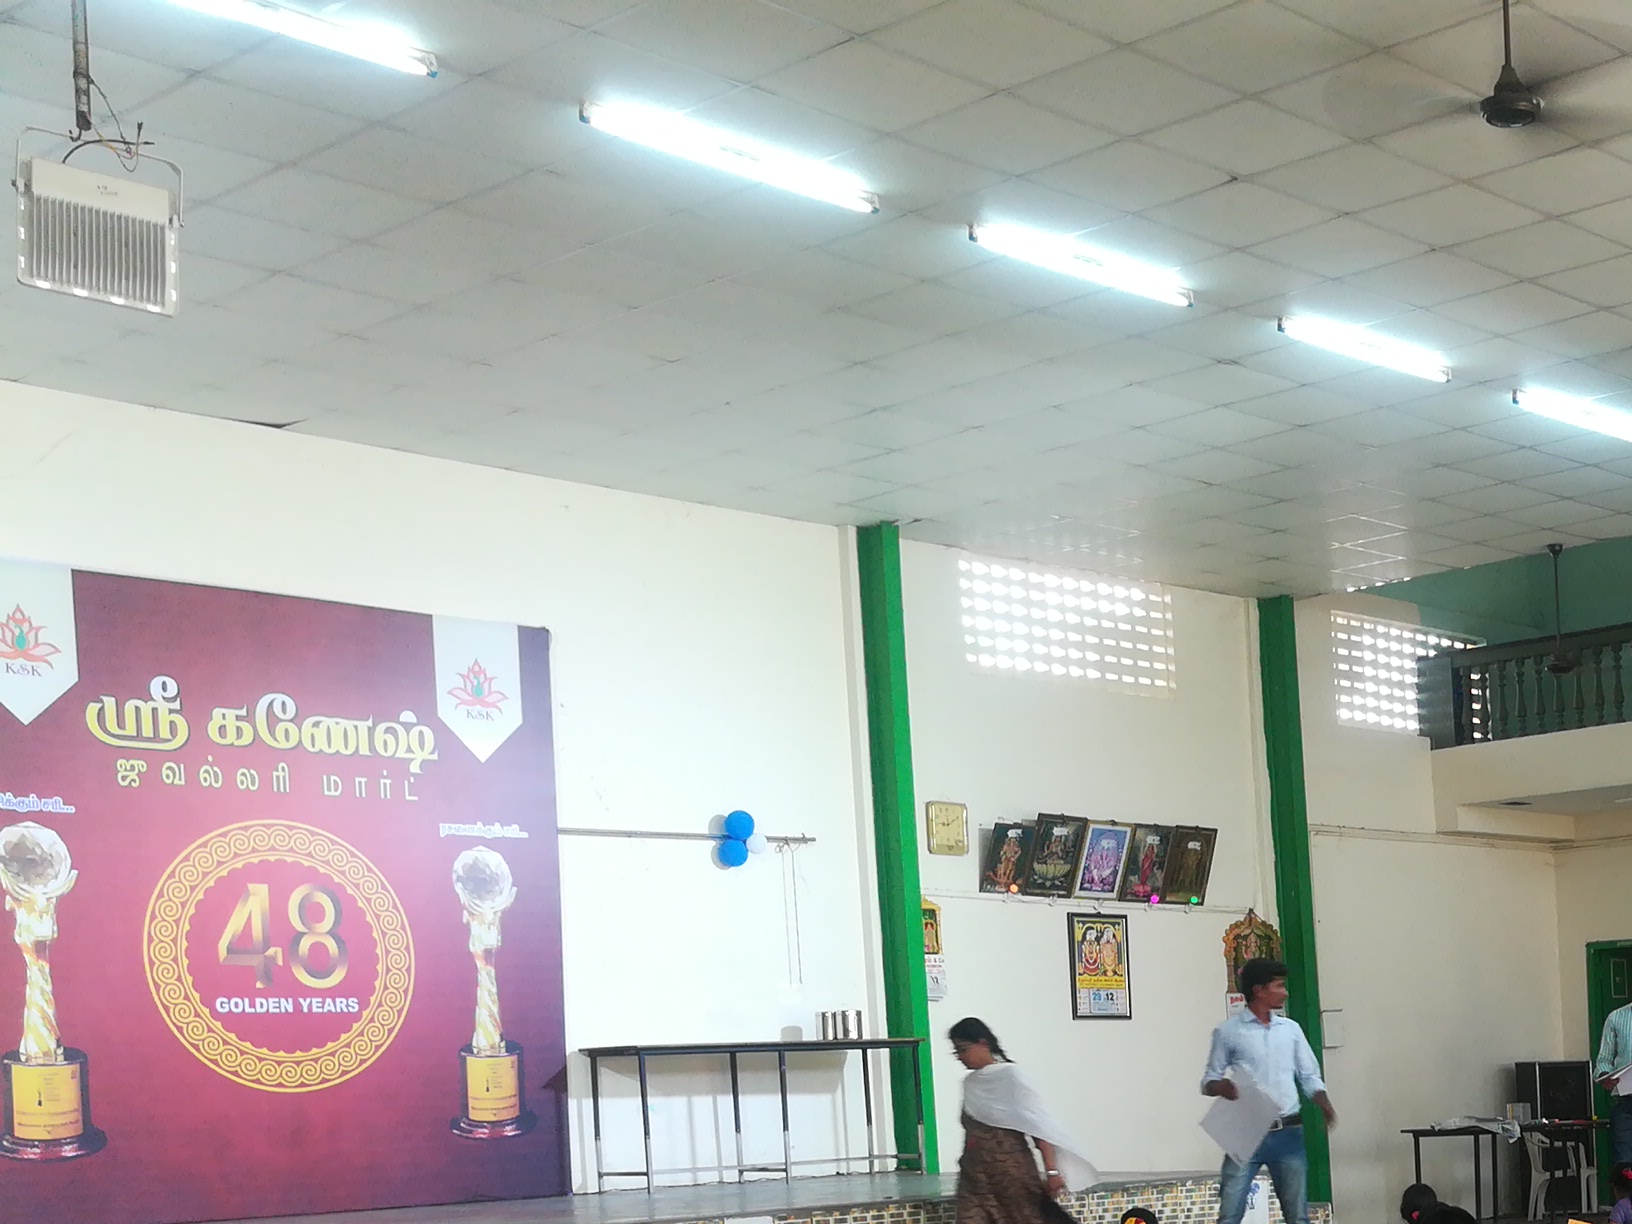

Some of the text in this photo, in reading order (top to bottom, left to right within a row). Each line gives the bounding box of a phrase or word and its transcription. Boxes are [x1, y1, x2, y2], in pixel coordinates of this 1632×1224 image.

[5, 662, 42, 677] KSK
[206, 692, 438, 774] கணேஷ்
[322, 769, 419, 801] மார்ட்
[218, 882, 349, 989] 48
[215, 997, 359, 1013] GOLDEN YEARS
[1106, 992, 1115, 1002] 12
